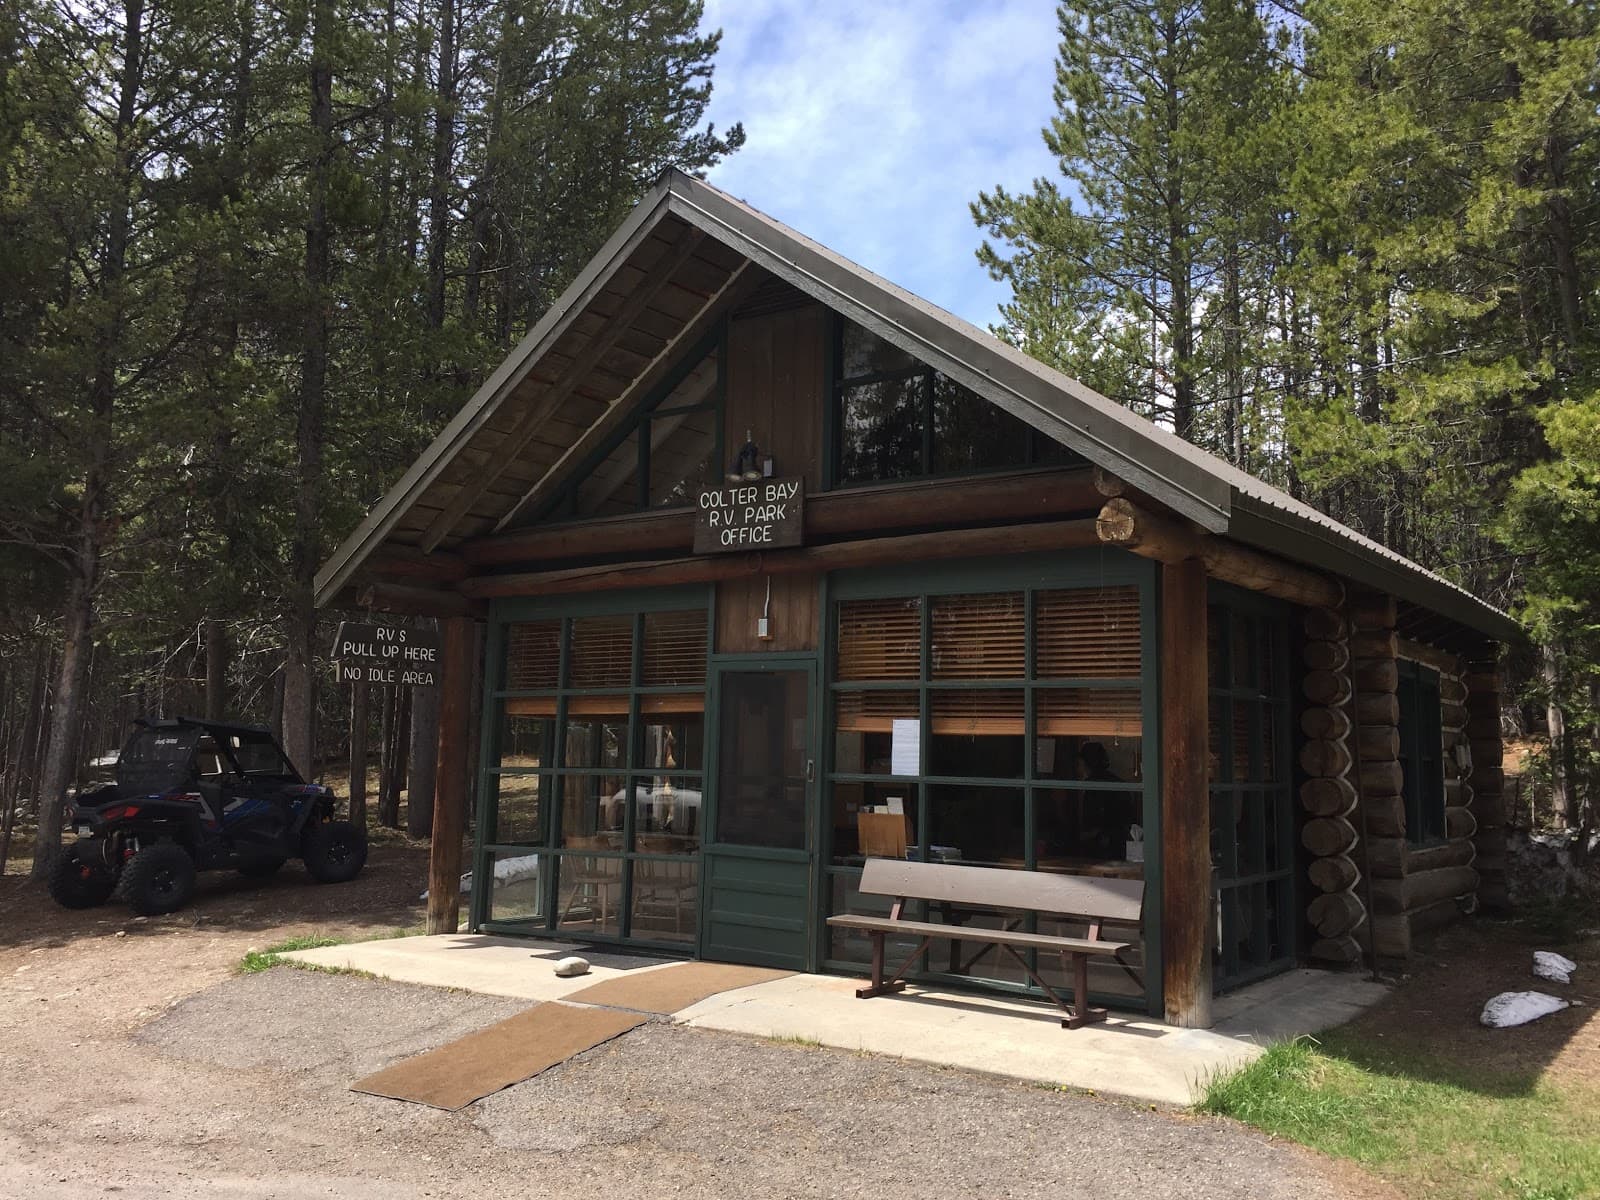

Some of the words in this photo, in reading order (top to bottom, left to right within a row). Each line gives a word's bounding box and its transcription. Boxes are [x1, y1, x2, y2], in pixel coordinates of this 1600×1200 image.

[700, 487, 758, 509] COLTER
[765, 482, 798, 502] BAY
[710, 510, 737, 527] R.V.
[745, 504, 786, 524] PARK
[721, 525, 772, 546] OFFICE
[343, 641, 376, 657] PULL
[382, 645, 399, 658] UP
[404, 646, 436, 662] HERE
[344, 667, 361, 681] NO
[368, 668, 395, 683] IDLE
[402, 672, 434, 685] AREA
